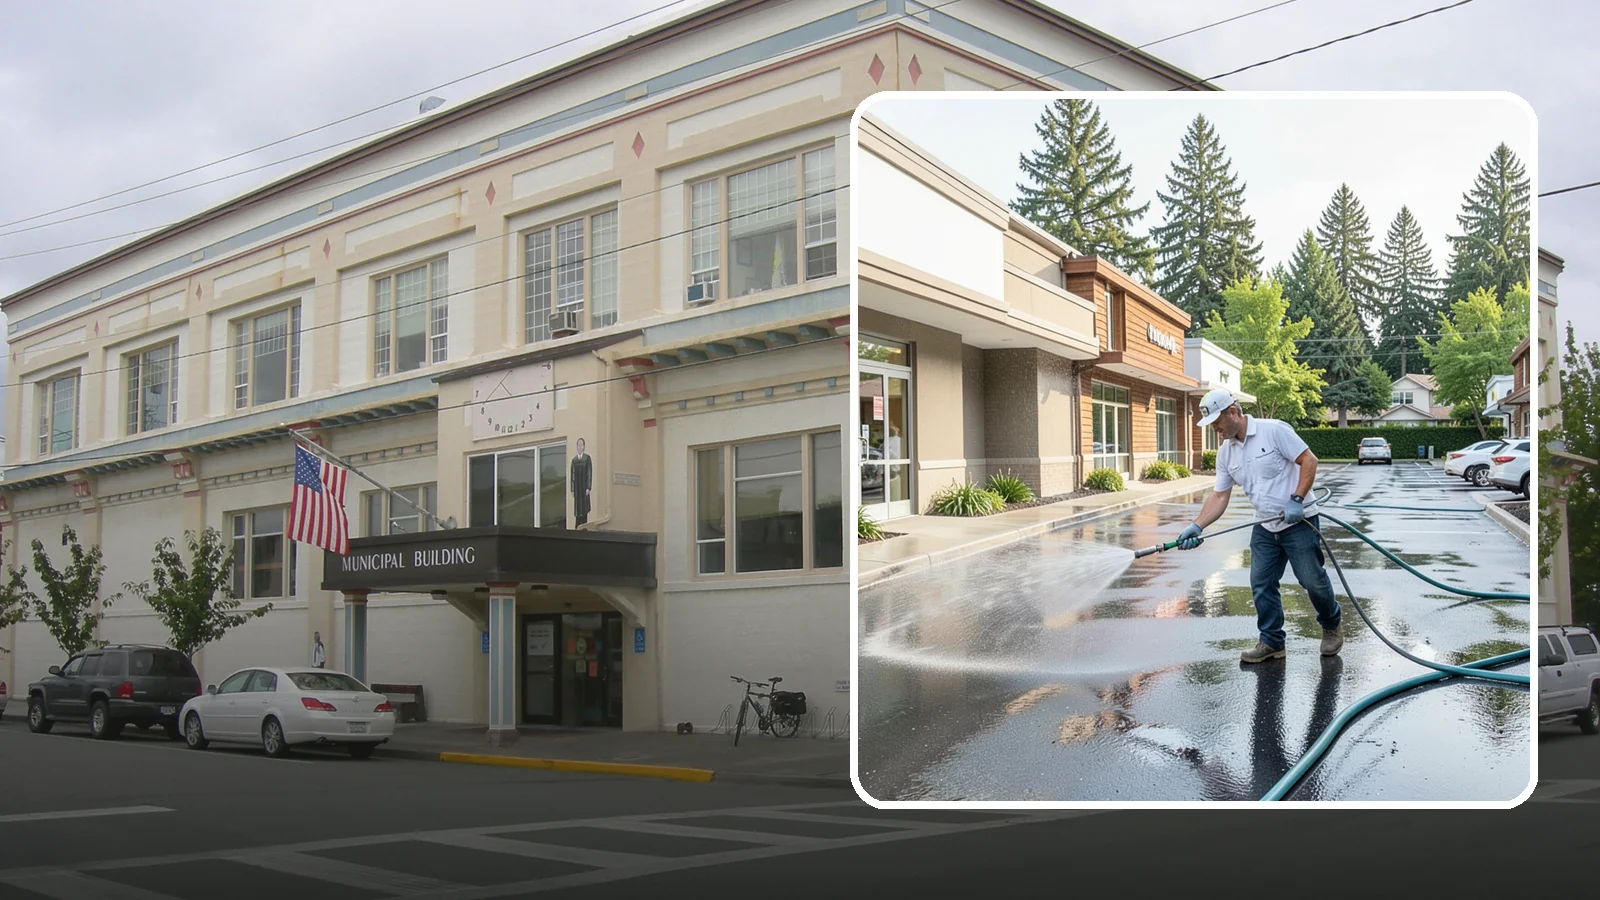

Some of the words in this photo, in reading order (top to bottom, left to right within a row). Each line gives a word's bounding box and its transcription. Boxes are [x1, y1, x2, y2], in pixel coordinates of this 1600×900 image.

[480, 406, 485, 415] 8
[536, 402, 540, 410] 4
[487, 417, 492, 426] 9
[528, 413, 533, 422] 3
[494, 423, 500, 432] 10
[521, 420, 525, 428] 2
[507, 425, 513, 433] 12
[342, 552, 405, 572] MUNICIPAL
[414, 546, 475, 567] BUILDING
